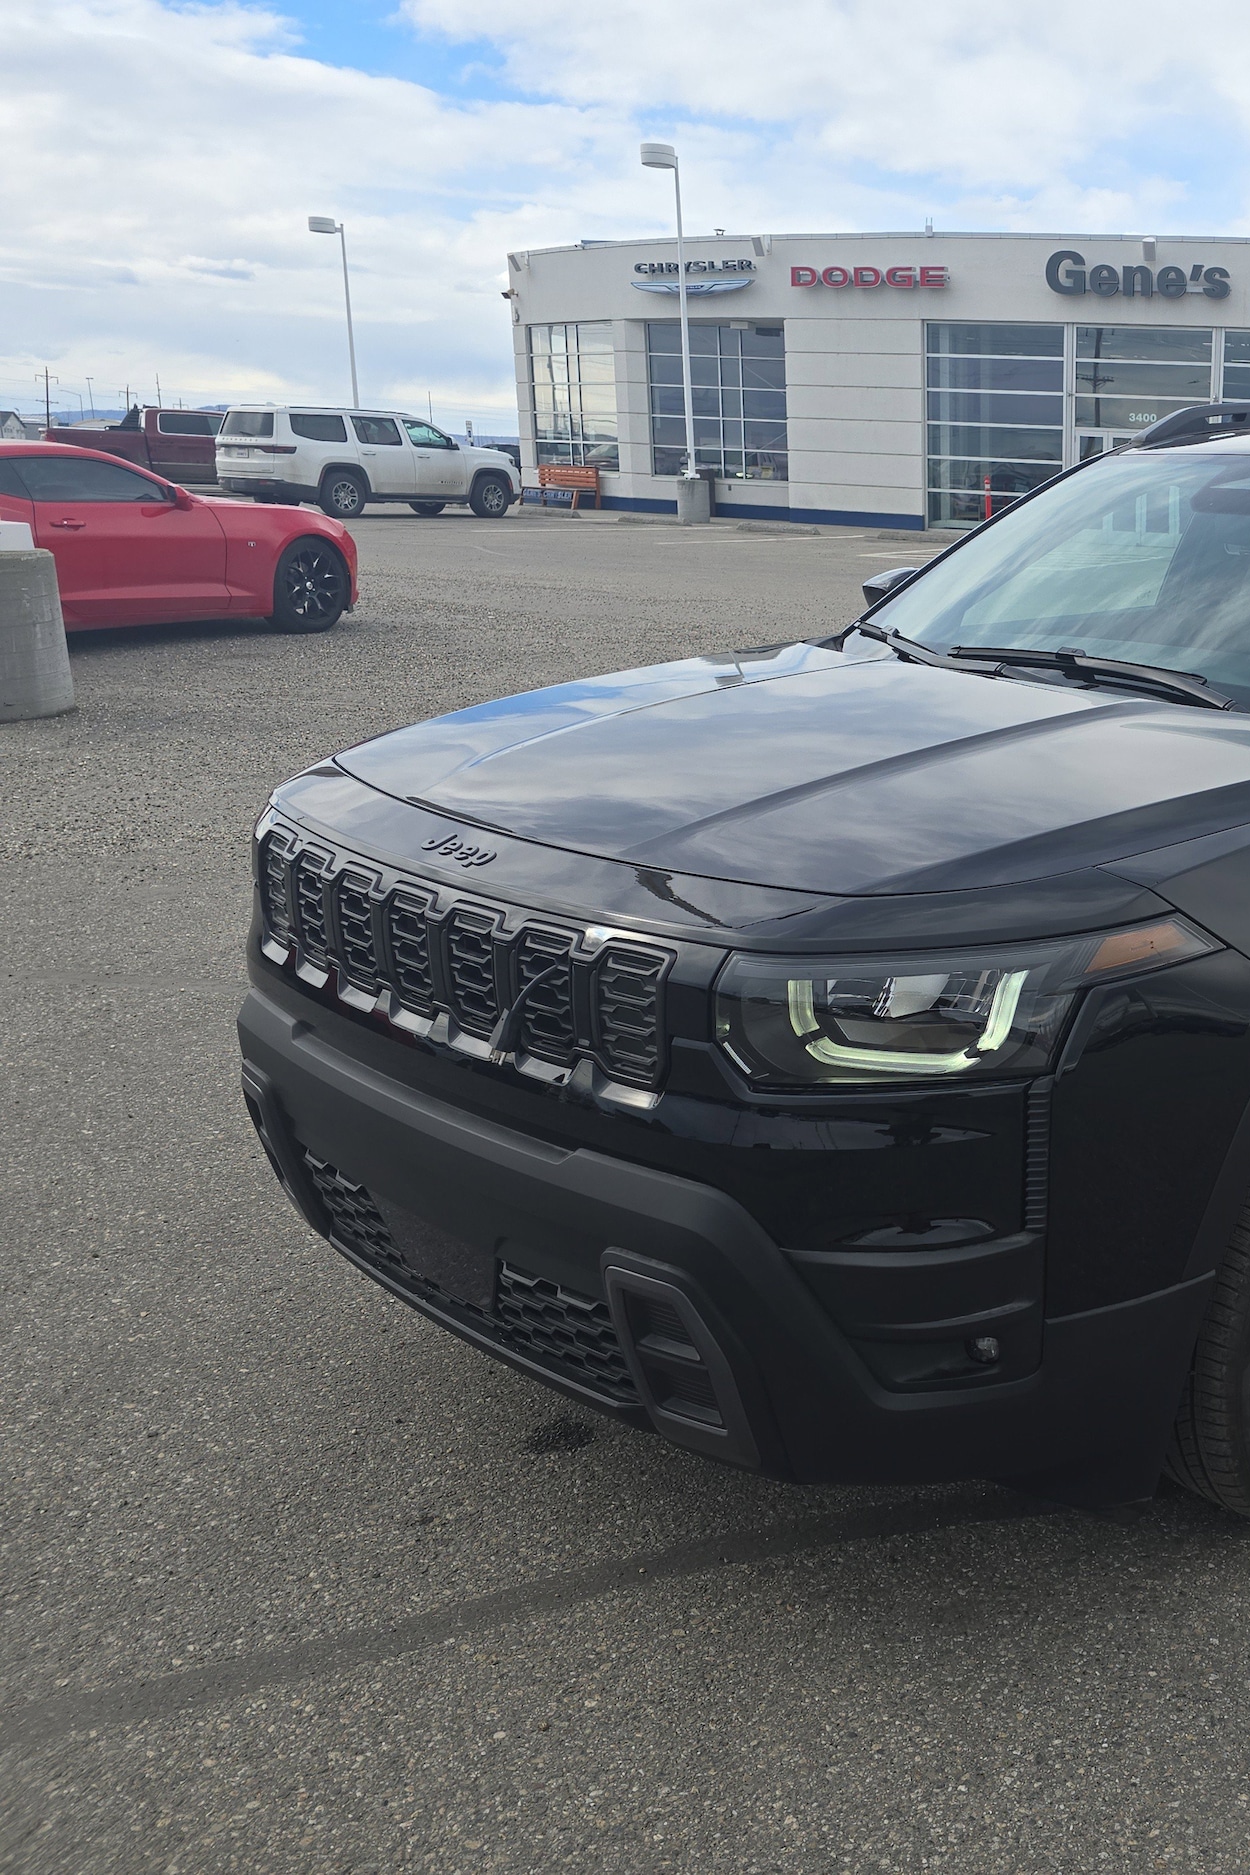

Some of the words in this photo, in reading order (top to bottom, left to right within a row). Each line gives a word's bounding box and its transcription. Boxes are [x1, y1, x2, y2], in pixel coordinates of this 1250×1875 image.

[790, 266, 948, 289] DODGE
[1045, 250, 1231, 300] Gene's
[1129, 412, 1158, 423] 3400
[420, 832, 498, 868] Jeep
